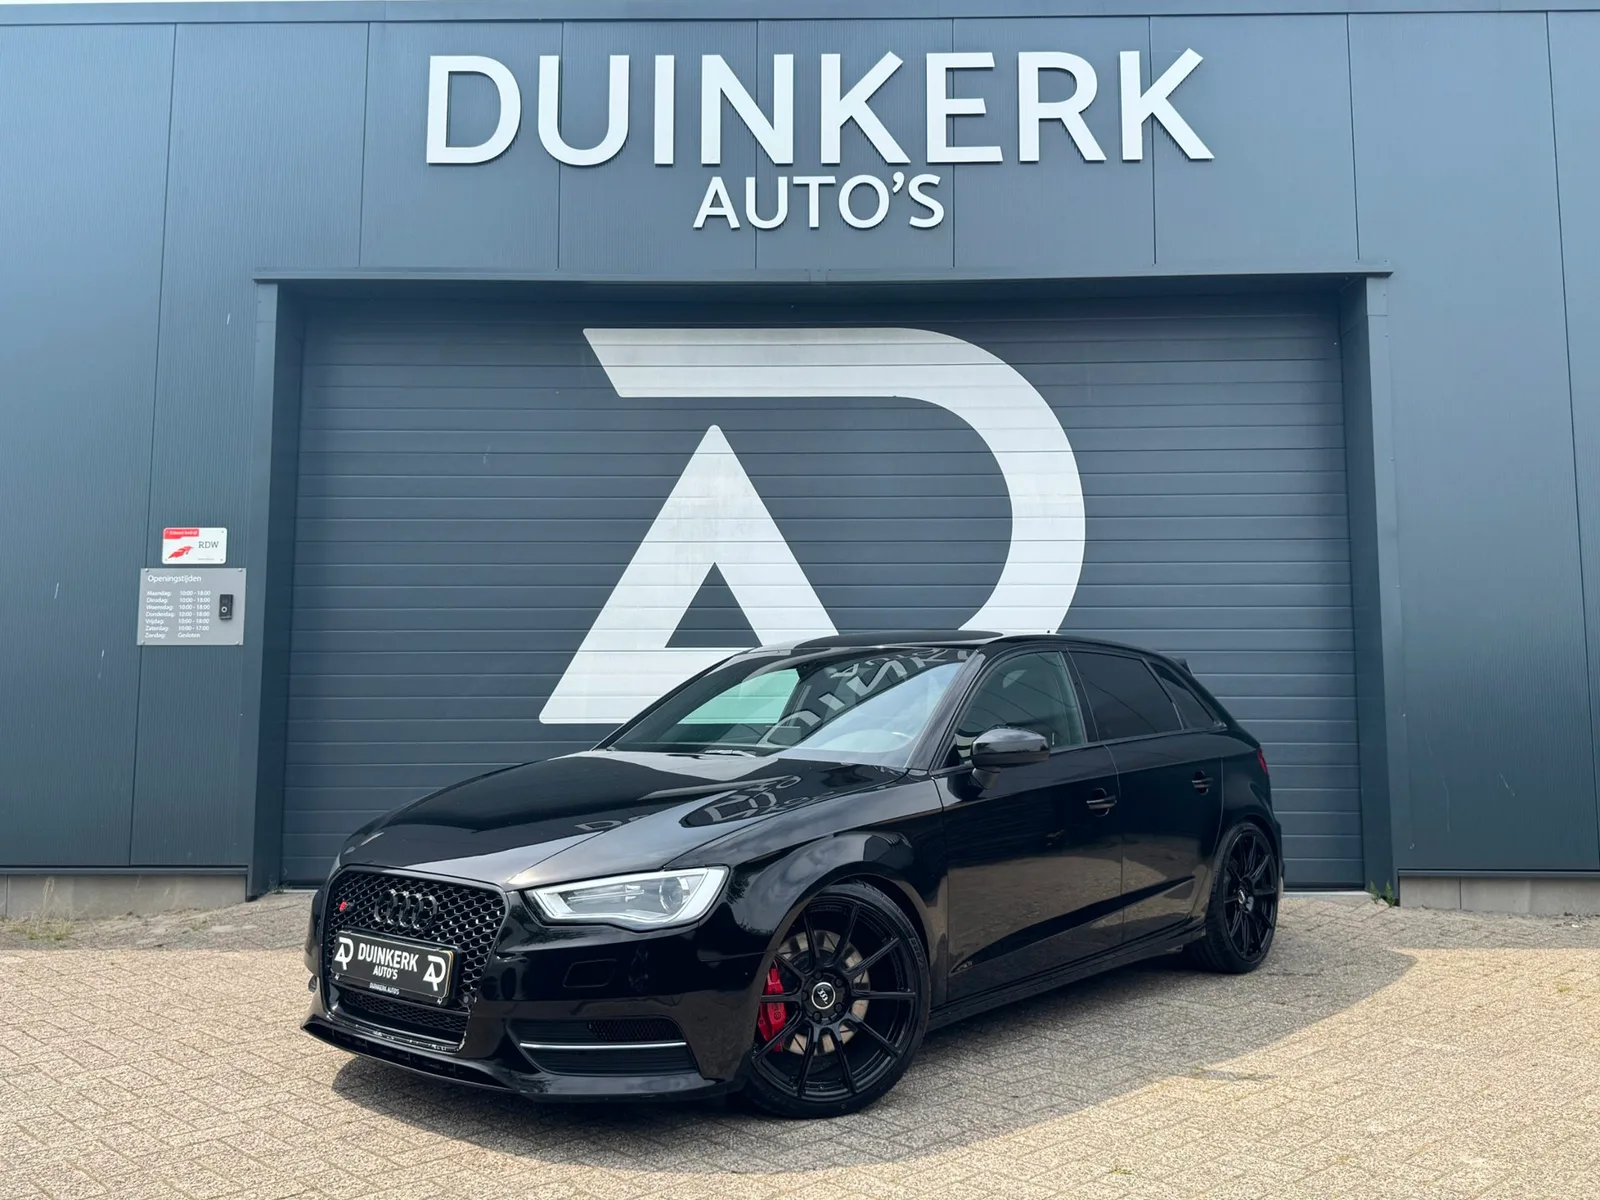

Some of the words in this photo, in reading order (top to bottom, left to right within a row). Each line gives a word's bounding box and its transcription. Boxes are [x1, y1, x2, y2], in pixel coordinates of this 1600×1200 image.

[426, 48, 1215, 166] DUINKERK
[693, 170, 945, 230] AUTO'S
[198, 541, 219, 549] RDW
[148, 575, 202, 583] Openingstijden
[357, 942, 420, 972] DUINKERK
[372, 964, 399, 980] AUTO'S
